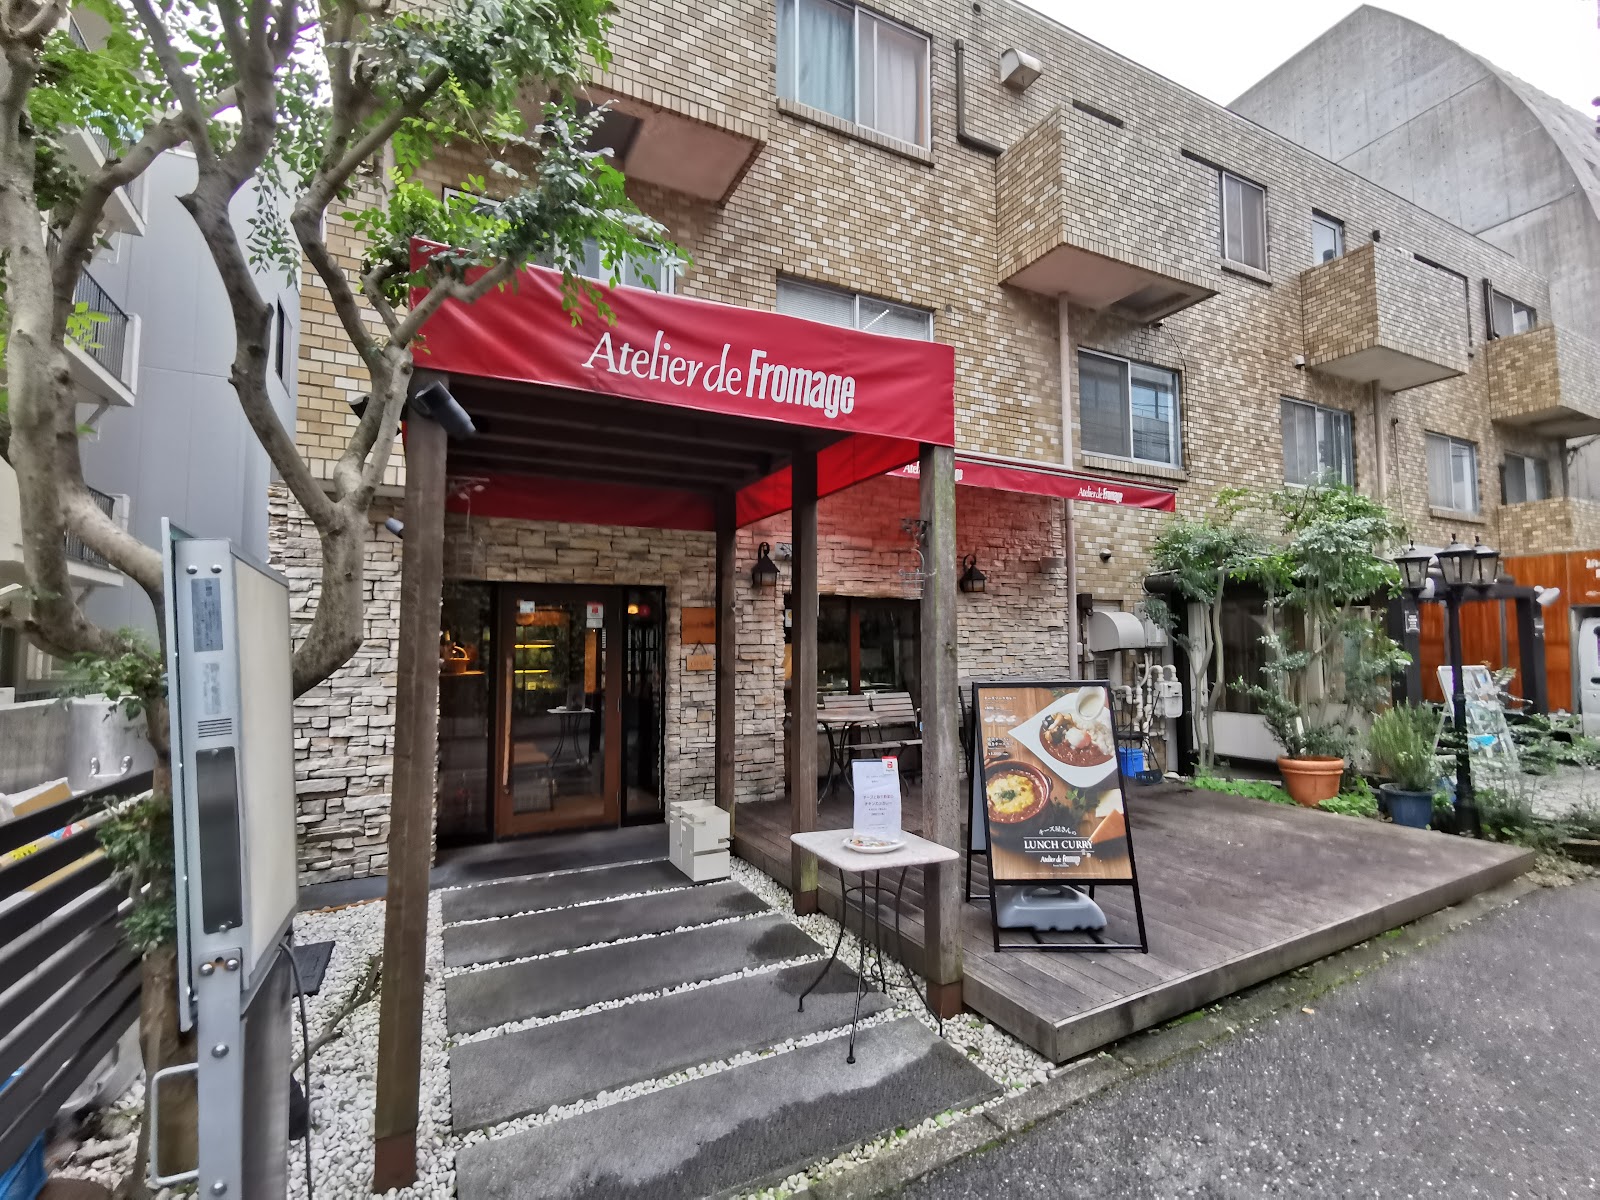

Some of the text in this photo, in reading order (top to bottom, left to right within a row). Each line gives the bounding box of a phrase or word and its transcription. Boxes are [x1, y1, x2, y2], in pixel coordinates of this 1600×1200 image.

[581, 330, 856, 418] Atelier de Fromage
[1077, 485, 1096, 498] Atelier
[1024, 840, 1093, 849] LUNCH CURRY
